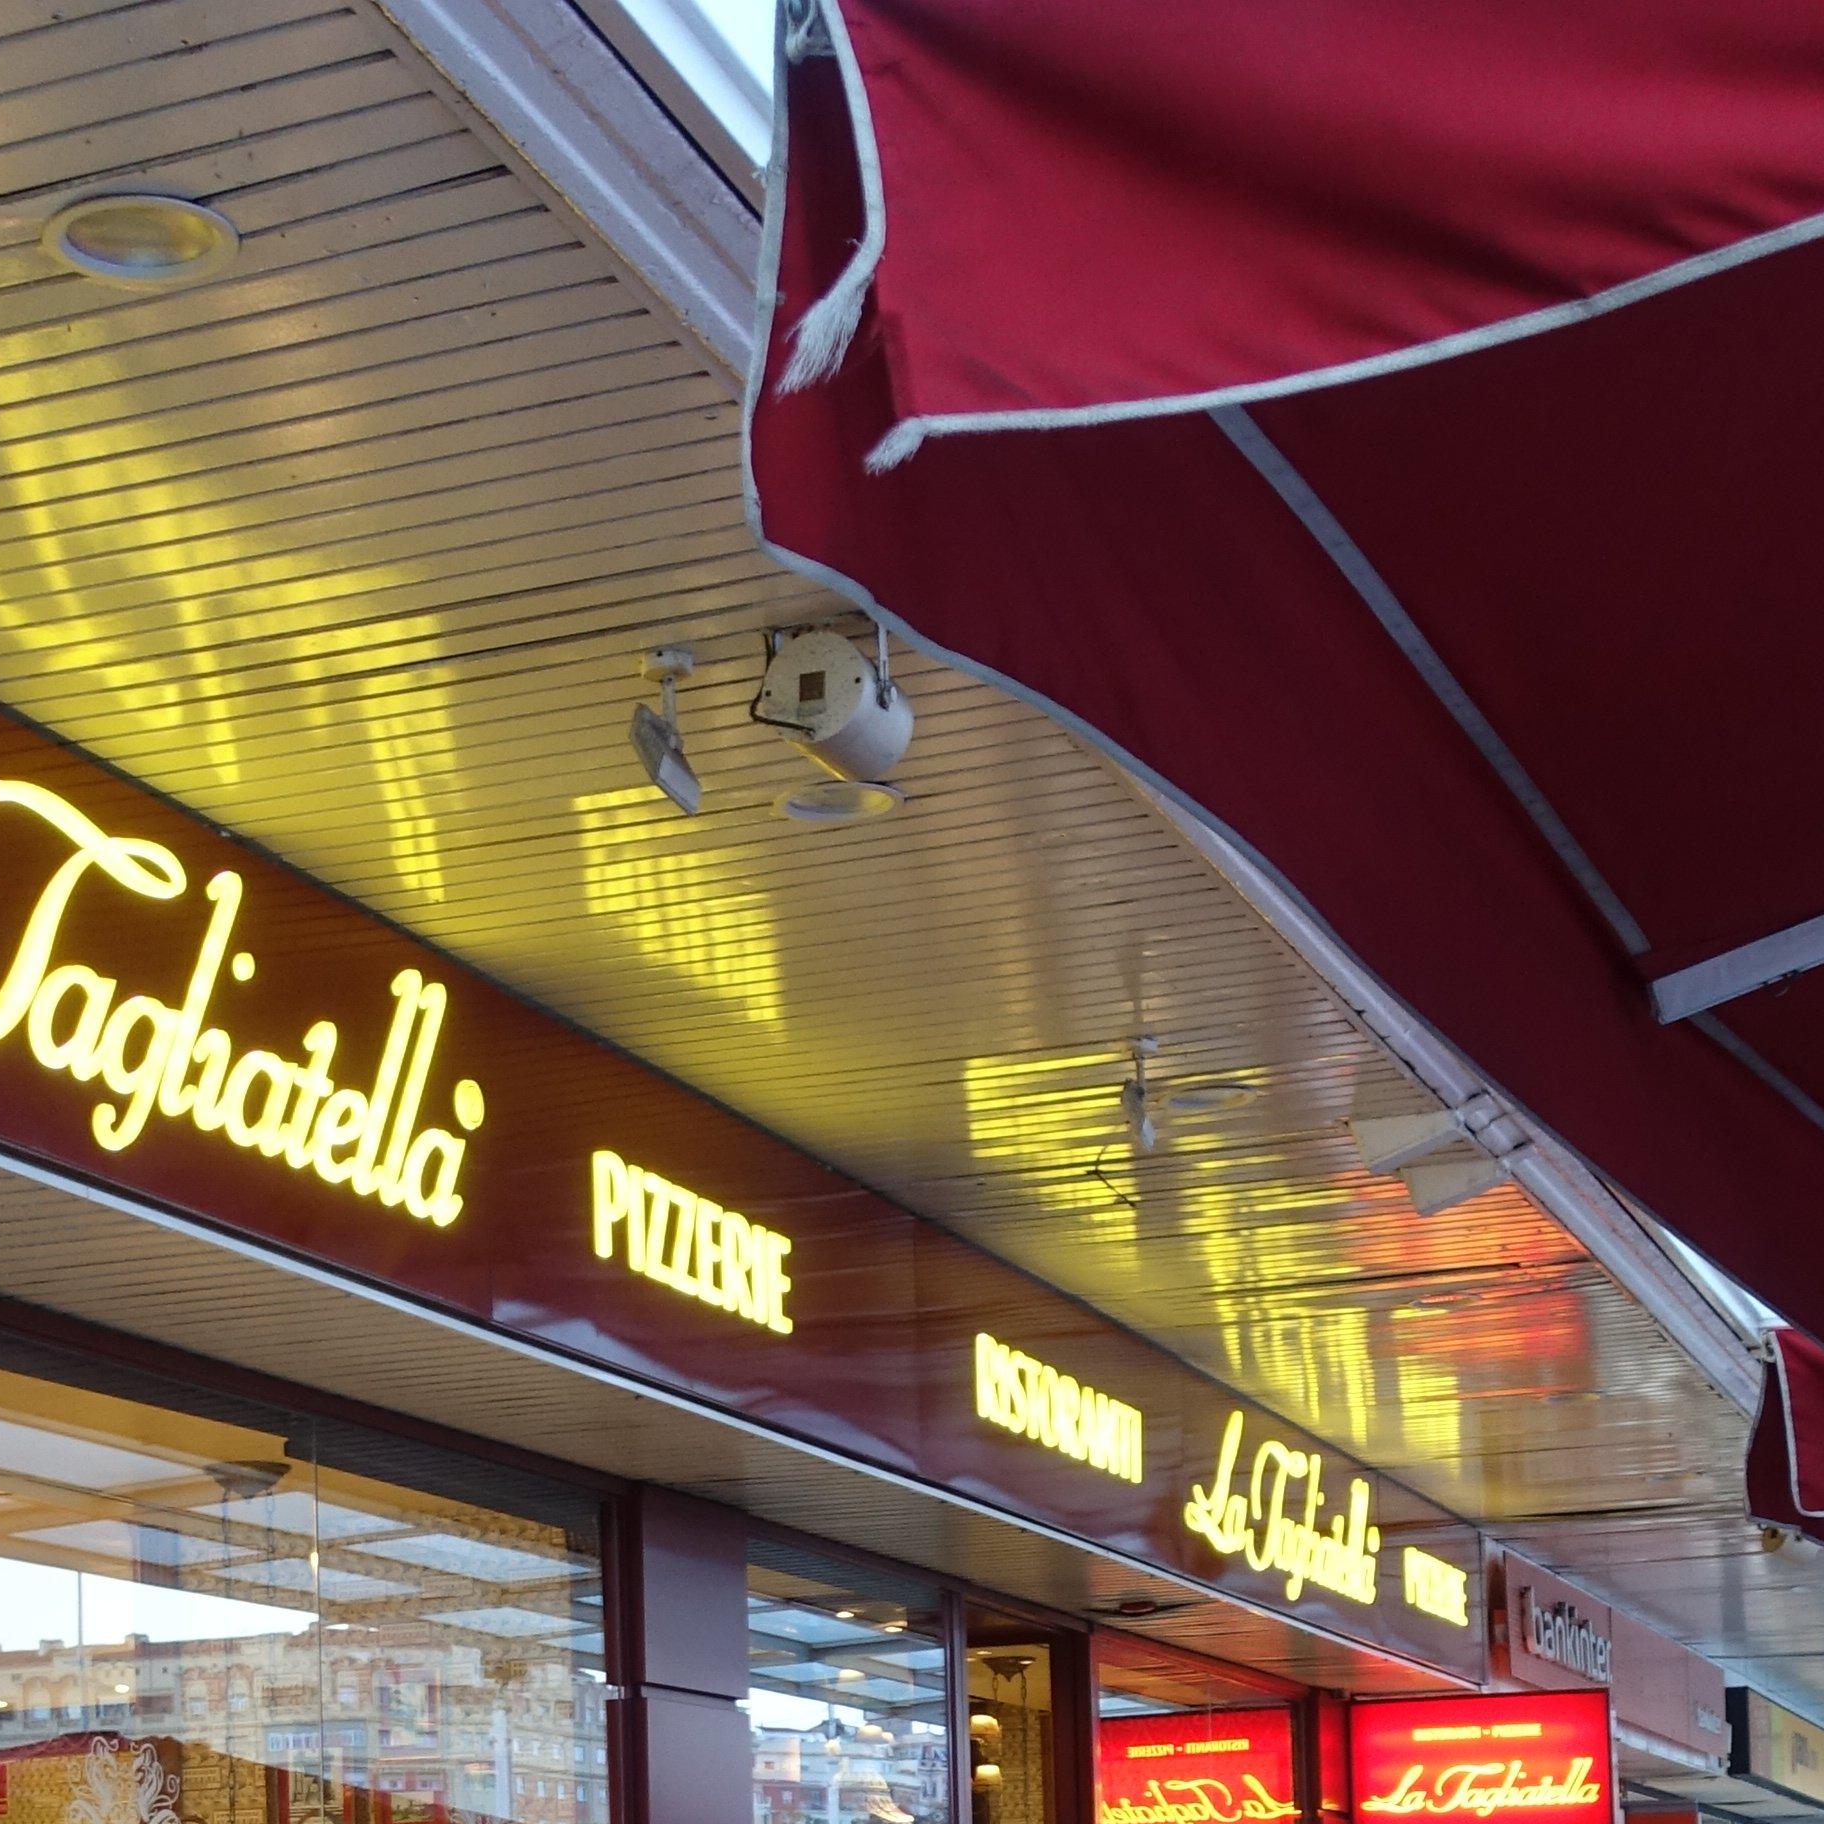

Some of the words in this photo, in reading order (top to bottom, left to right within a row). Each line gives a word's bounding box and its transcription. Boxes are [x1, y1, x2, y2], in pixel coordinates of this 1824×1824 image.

[591, 1148, 794, 1335] PIZZERIE
[975, 1332, 1144, 1484] RISTORANTI
[1183, 1409, 1249, 1555] La
[1520, 1586, 1612, 1684] bankinter
[1362, 1764, 1426, 1814] La
[1425, 1757, 1601, 1817] Tagliatella
